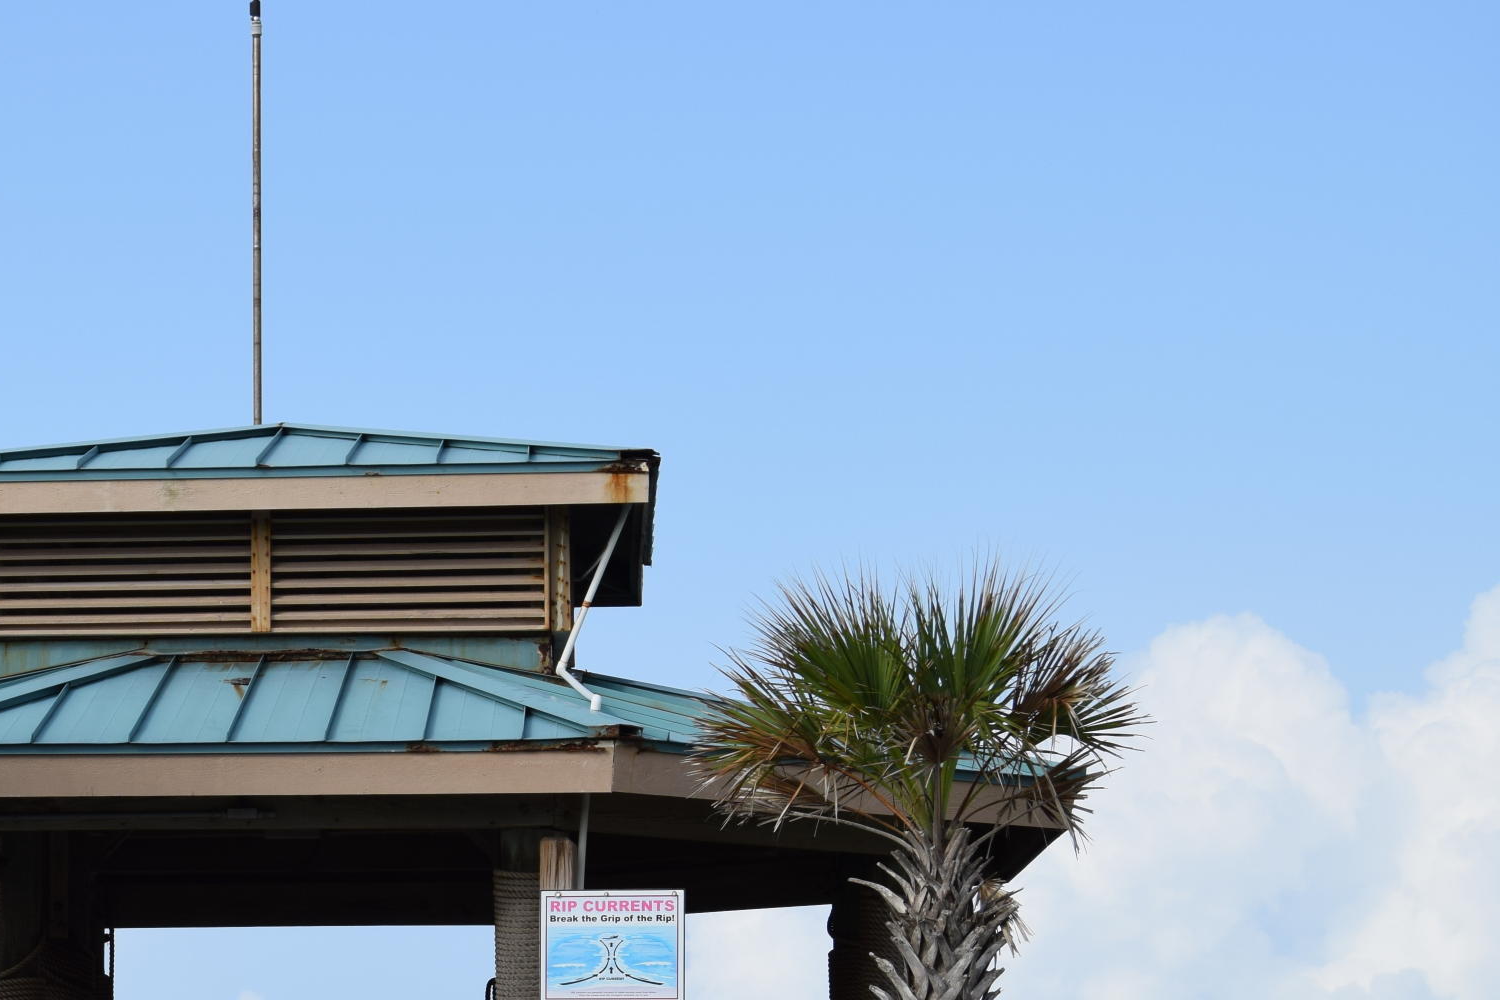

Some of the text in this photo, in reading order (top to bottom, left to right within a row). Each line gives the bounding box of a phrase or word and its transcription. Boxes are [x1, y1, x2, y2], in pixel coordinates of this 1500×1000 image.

[550, 900, 675, 912] RIP CURRENTS
[550, 914, 675, 924] Break the Grip of the Rip!
